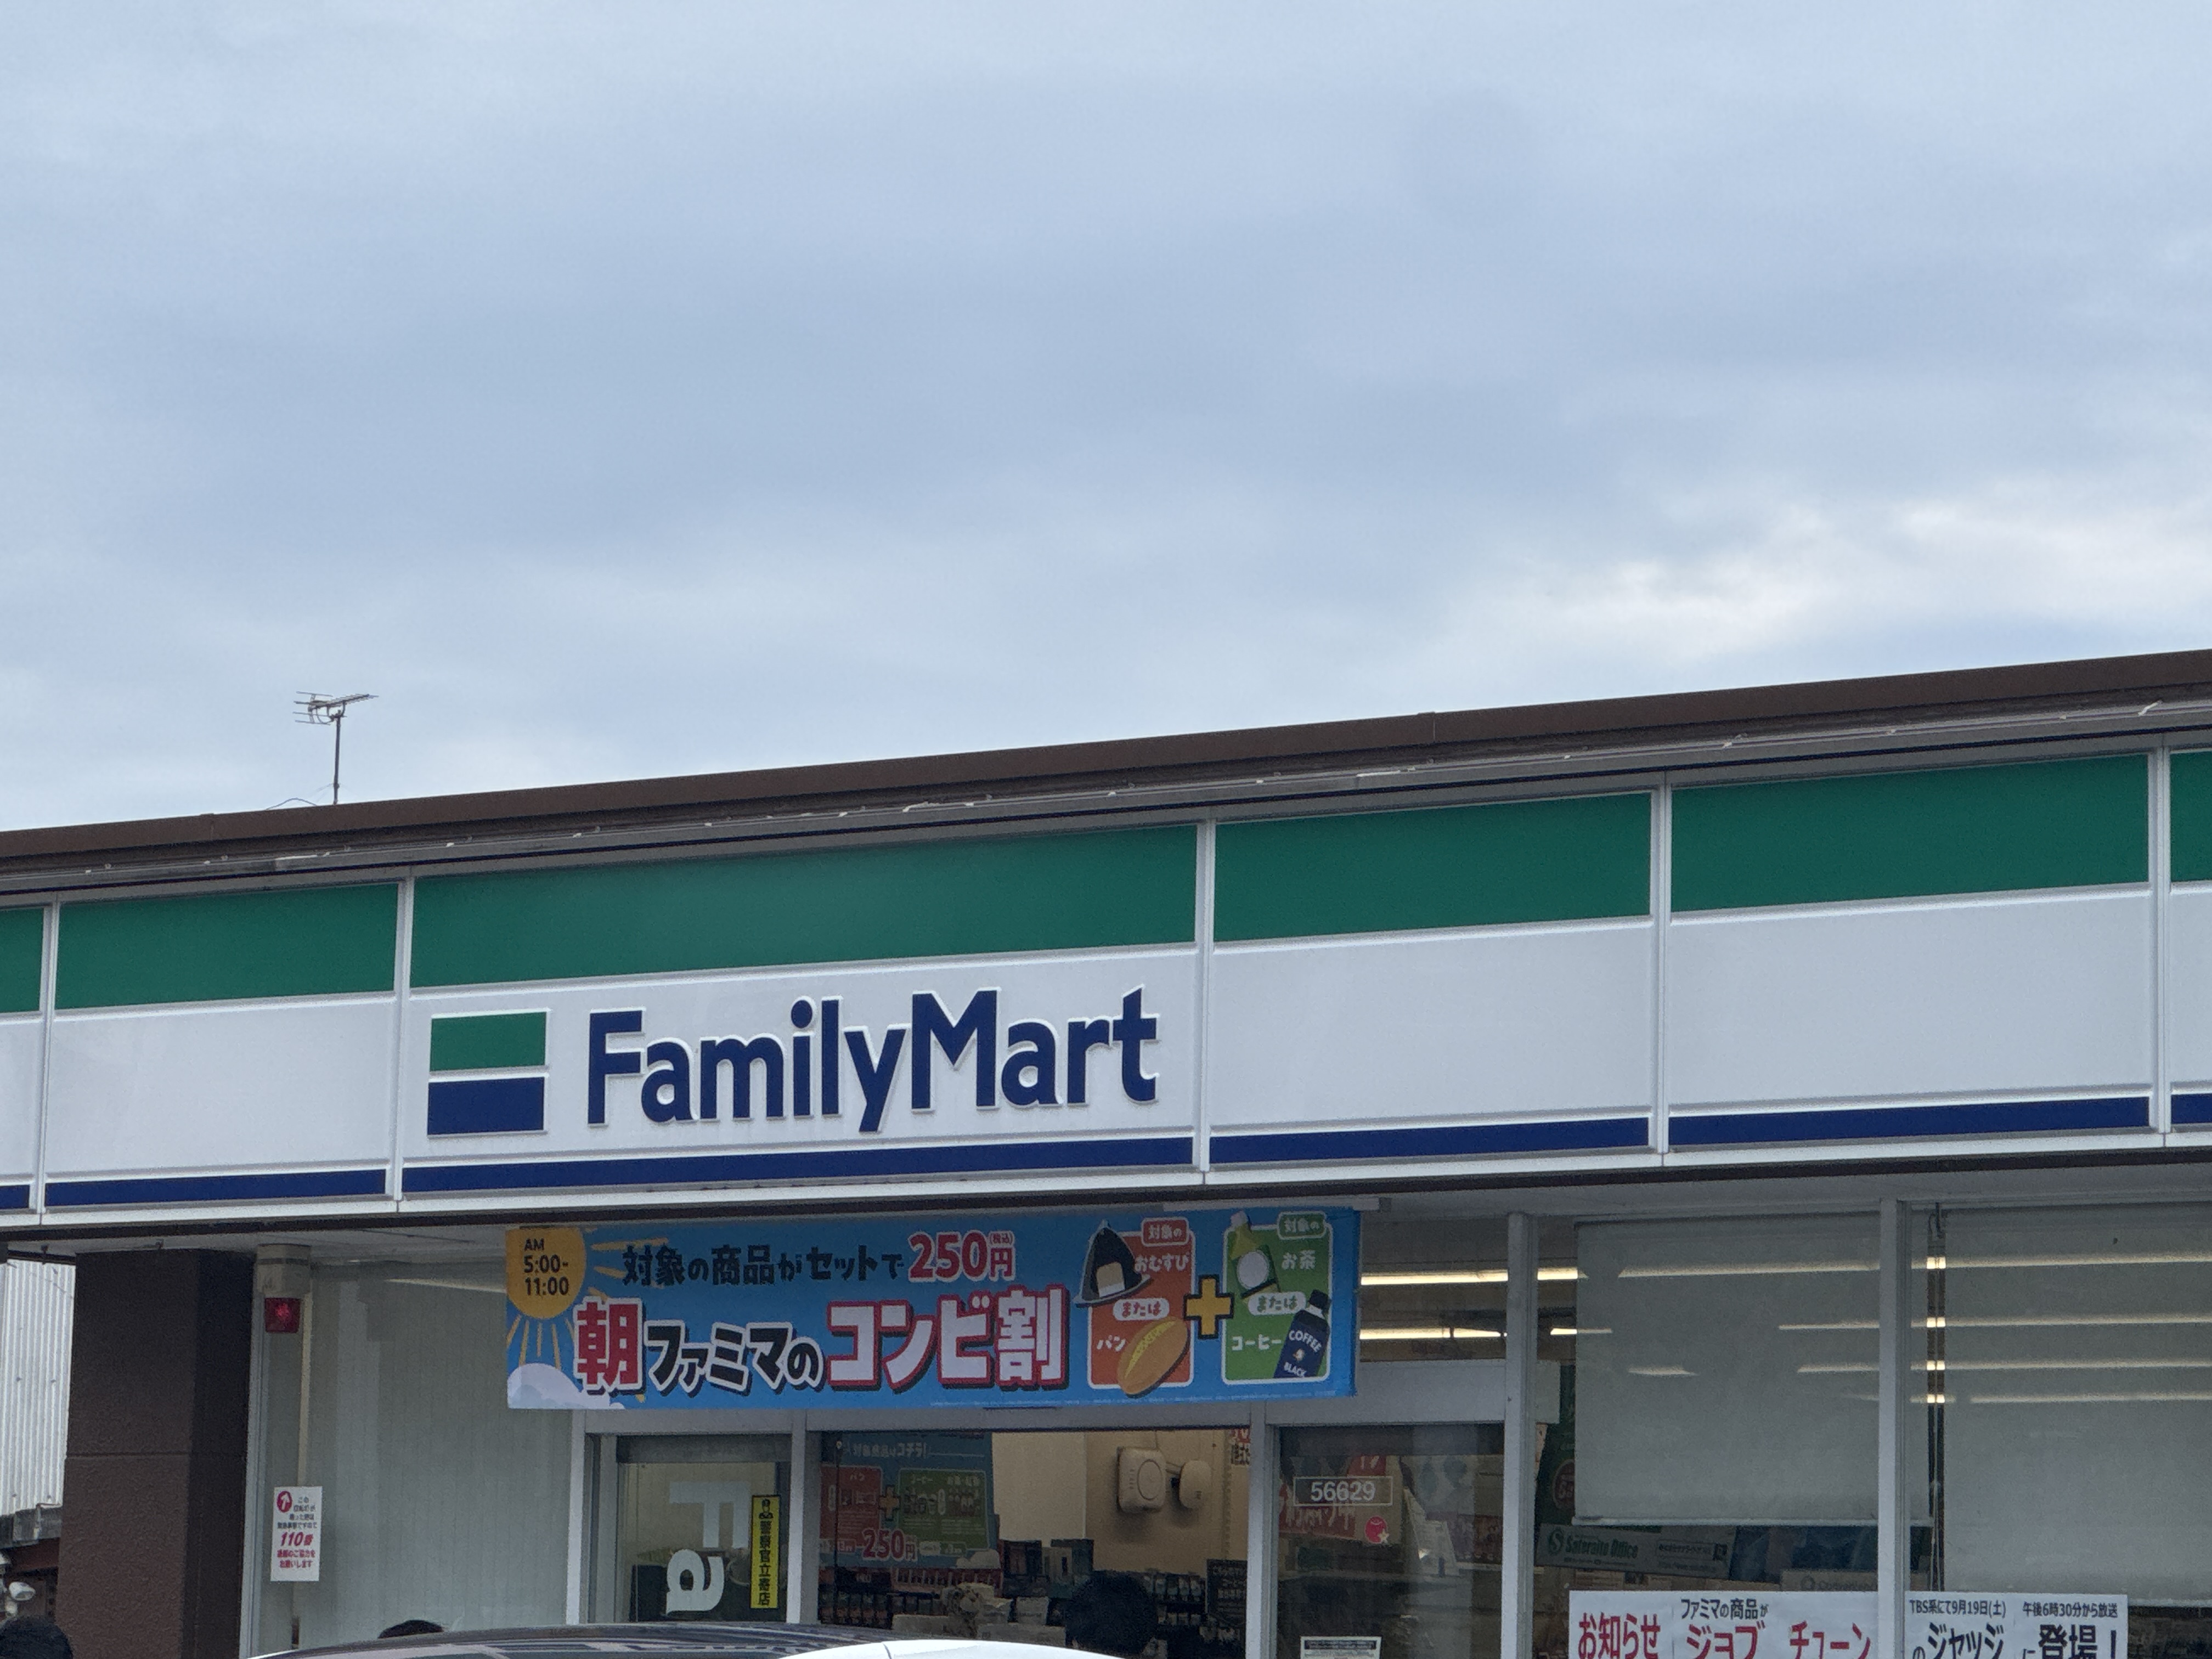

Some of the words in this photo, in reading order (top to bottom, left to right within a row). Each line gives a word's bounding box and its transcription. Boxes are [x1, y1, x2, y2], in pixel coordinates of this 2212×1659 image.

[588, 985, 1159, 1132] FamilyMart
[1148, 1224, 1182, 1240] 対象の
[524, 1238, 544, 1251] AM
[1135, 1252, 1189, 1272] おむすび
[1282, 1250, 1316, 1269] お茶
[524, 1277, 569, 1296] 11:00
[1122, 1301, 1161, 1318] または
[1257, 1295, 1299, 1313] または
[1097, 1335, 1126, 1352] パン
[1232, 1334, 1282, 1351] コーヒー
[1289, 1330, 1322, 1352] COFFEE
[1284, 1362, 1307, 1378] BLACK
[1310, 1481, 1376, 1502] 56629
[280, 1531, 314, 1547] 110番
[1681, 1598, 1769, 1620] ファミマの商品が
[1909, 1599, 2006, 1618] TBS系にて9月19日(土)
[2023, 1601, 2118, 1618] 午後6時30分から放送
[1578, 1612, 1661, 1659] お知らせ
